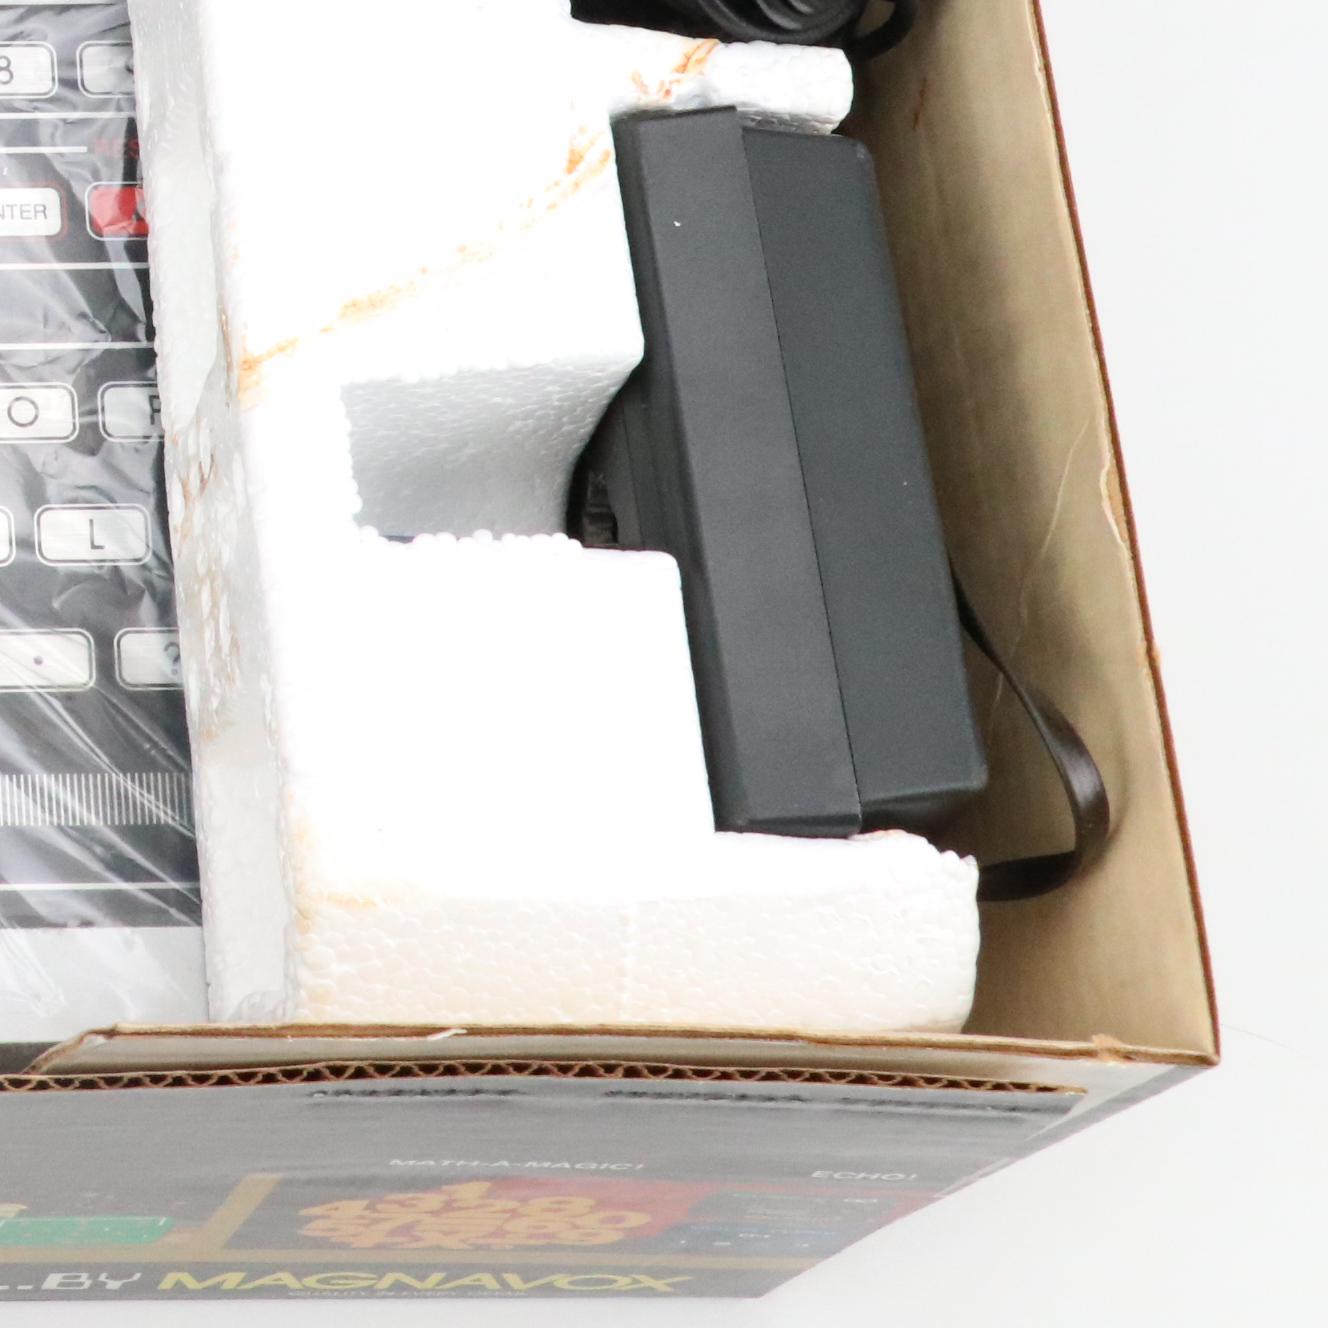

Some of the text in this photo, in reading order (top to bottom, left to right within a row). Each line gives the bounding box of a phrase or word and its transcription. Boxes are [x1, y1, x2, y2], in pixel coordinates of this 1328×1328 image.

[7, 397, 38, 427] O
[90, 519, 104, 549] L
[812, 1168, 919, 1183] ECHO!
[156, 1270, 694, 1294] MAGNAVOX
